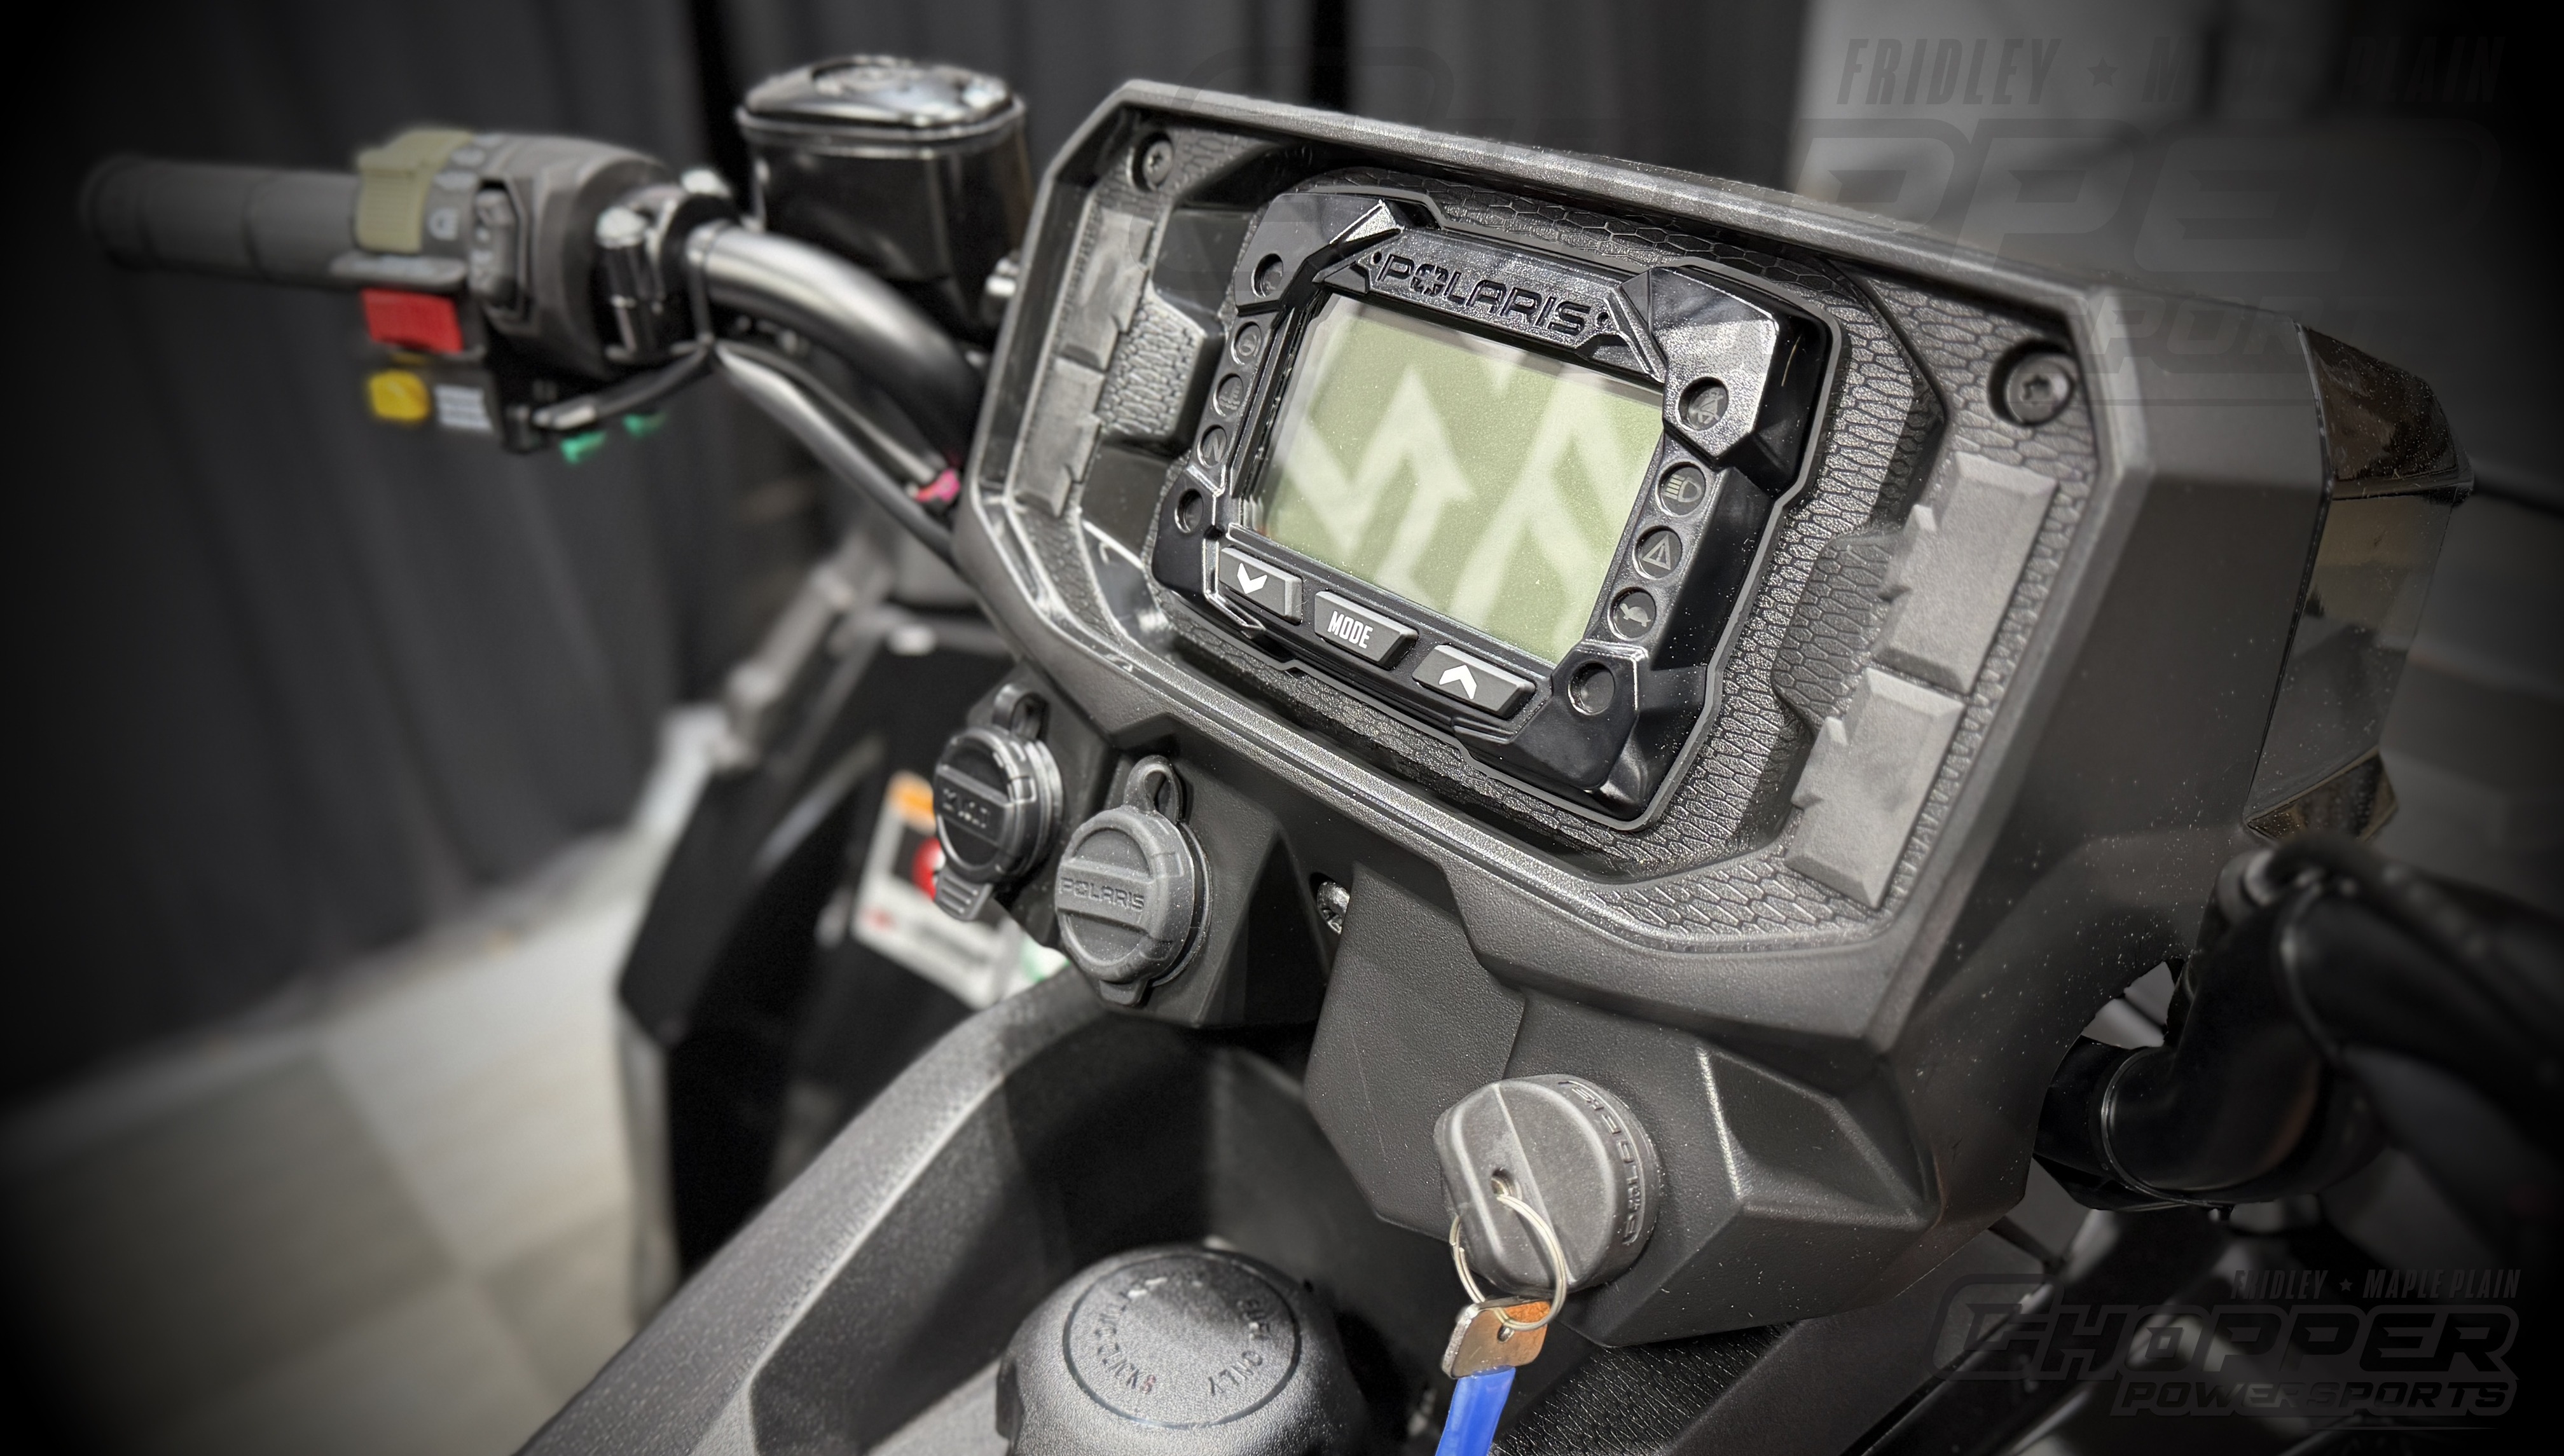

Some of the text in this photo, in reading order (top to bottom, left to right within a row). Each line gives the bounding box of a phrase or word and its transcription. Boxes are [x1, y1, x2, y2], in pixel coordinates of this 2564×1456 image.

[1376, 254, 1592, 336] POLARIS
[1327, 610, 1374, 649] MODE
[1058, 877, 1145, 912] POLARIS
[1097, 1341, 1157, 1394] CLICKS
